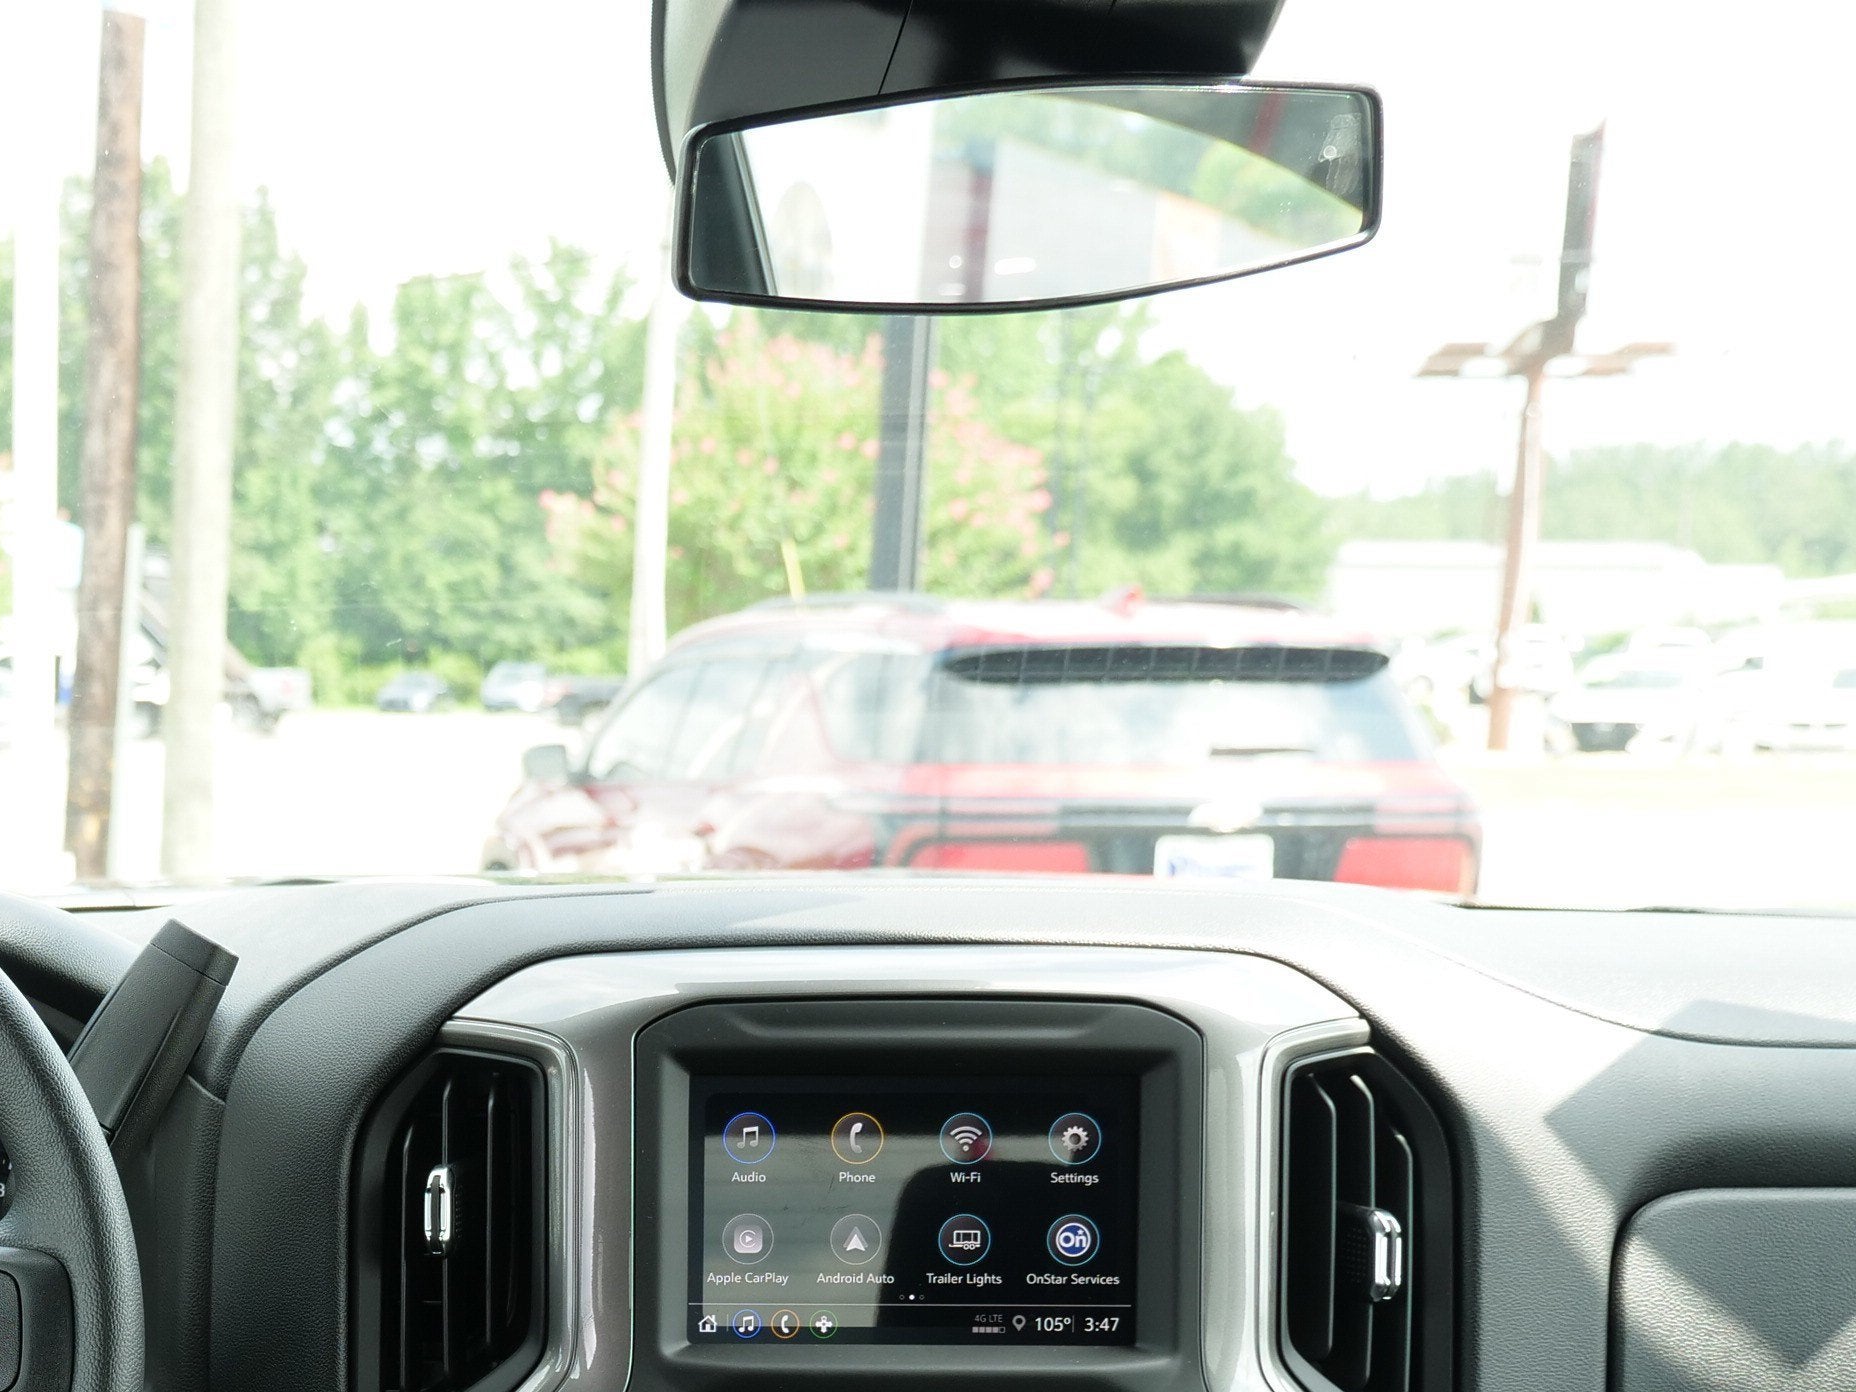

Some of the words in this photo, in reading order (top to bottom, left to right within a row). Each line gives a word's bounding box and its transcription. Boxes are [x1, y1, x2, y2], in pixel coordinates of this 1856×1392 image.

[731, 1171, 767, 1184] Audio
[838, 1171, 876, 1184] Phone
[950, 1172, 981, 1183] Wi-Fi
[1050, 1172, 1099, 1186] Settings
[707, 1272, 742, 1287] Apple
[744, 1272, 789, 1286] CarPlay
[816, 1272, 863, 1284] Android
[866, 1273, 895, 1284] Auto
[926, 1272, 963, 1285] Trailer
[966, 1273, 1002, 1287] Lights
[1026, 1273, 1067, 1285] OnStar
[1070, 1273, 1120, 1285] Services
[974, 1314, 987, 1323] 4G
[988, 1314, 1003, 1323] LTE
[1084, 1317, 1120, 1332] 3:47
